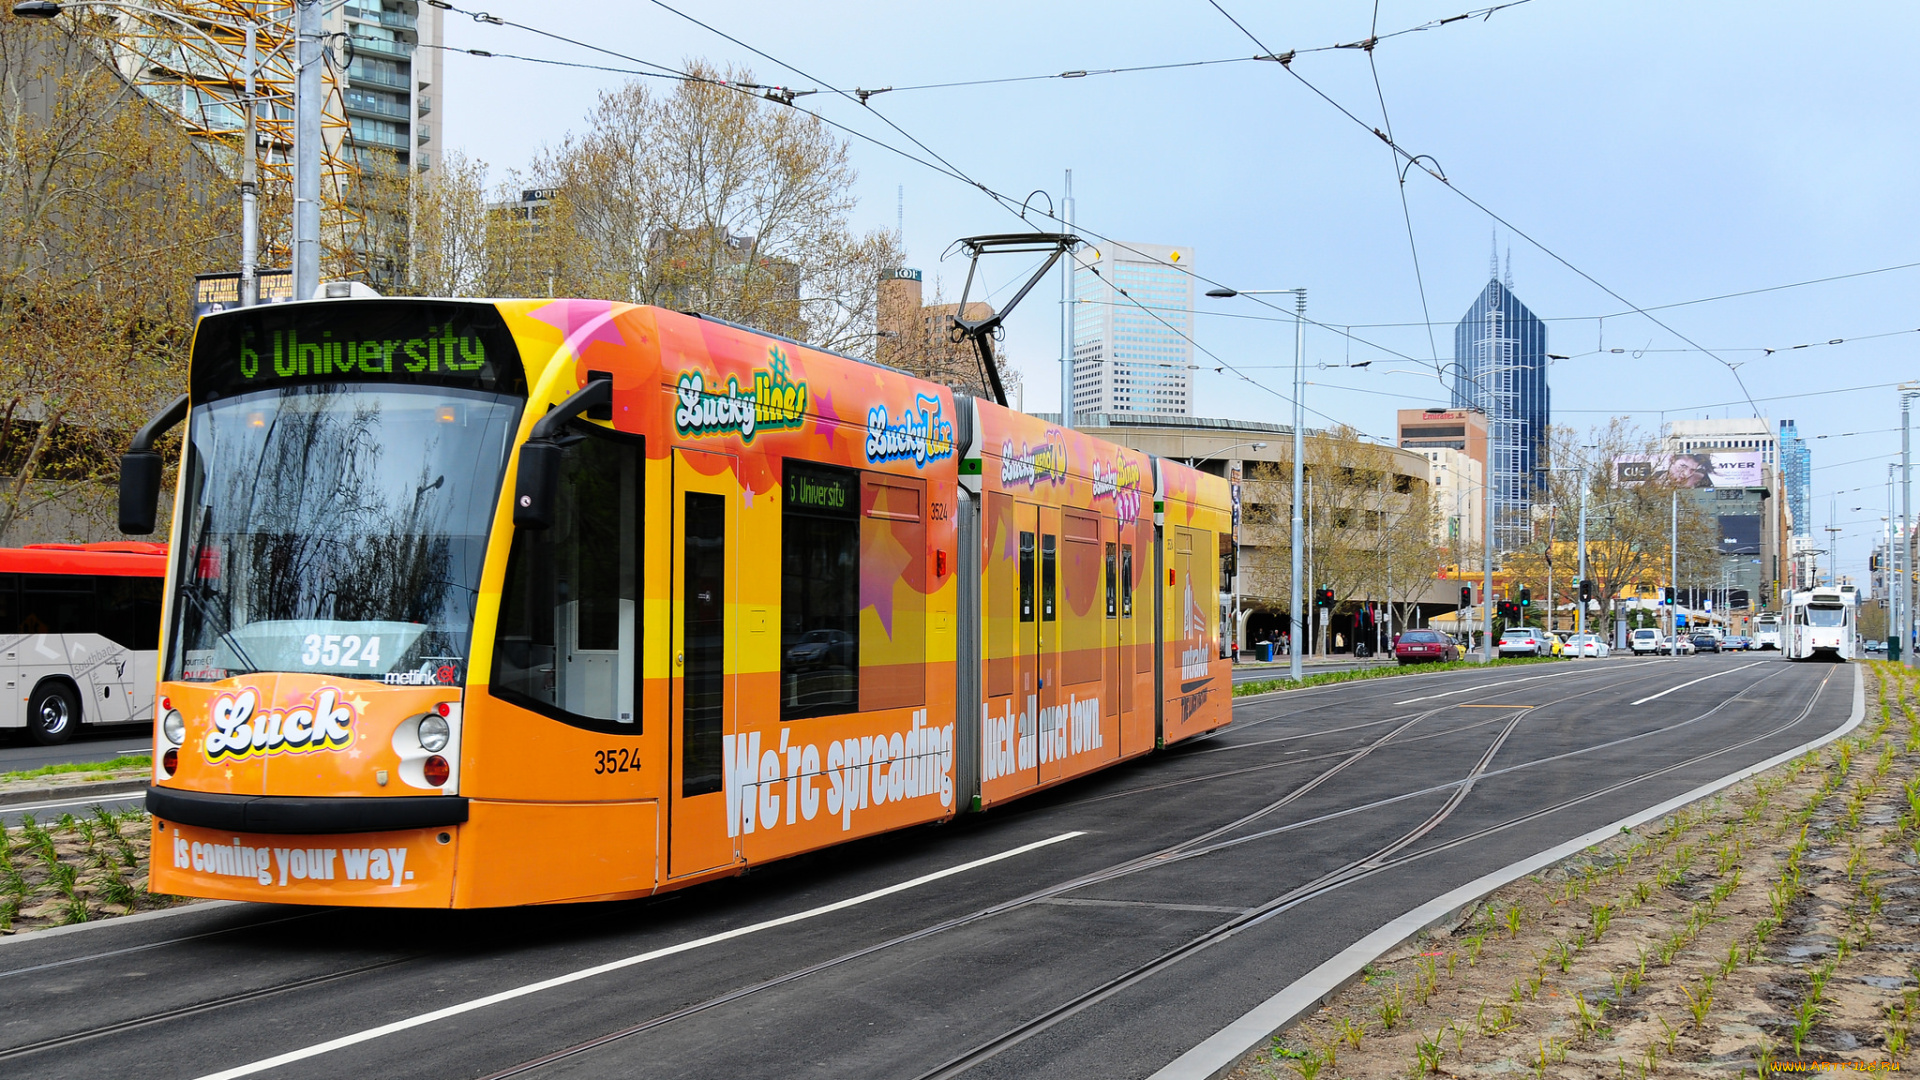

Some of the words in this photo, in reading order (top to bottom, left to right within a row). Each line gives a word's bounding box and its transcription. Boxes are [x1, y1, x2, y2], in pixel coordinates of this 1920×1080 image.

[200, 278, 239, 292] HISTORY
[260, 288, 268, 299] IS
[269, 286, 292, 298] COMIN
[261, 274, 292, 288] HISTOR
[198, 292, 207, 303] IS
[209, 291, 238, 302] COMING
[241, 331, 258, 378] 6
[274, 323, 485, 377] University
[1423, 412, 1454, 420] Emirates
[1624, 467, 1645, 476] CUE
[800, 476, 845, 507] University
[931, 502, 948, 521] 3524
[74, 642, 118, 675] southbank
[302, 634, 381, 668] 3524
[385, 671, 436, 685] metlink
[206, 691, 350, 757] Luck
[594, 748, 641, 775] 3524
[827, 708, 954, 831] spreading
[983, 699, 1015, 782] luck
[1018, 694, 1036, 771] all
[1040, 703, 1068, 764] over
[1070, 693, 1103, 756] town.
[173, 829, 189, 869] is
[191, 837, 272, 885] coming
[274, 848, 337, 887] your
[342, 847, 414, 888] way.
